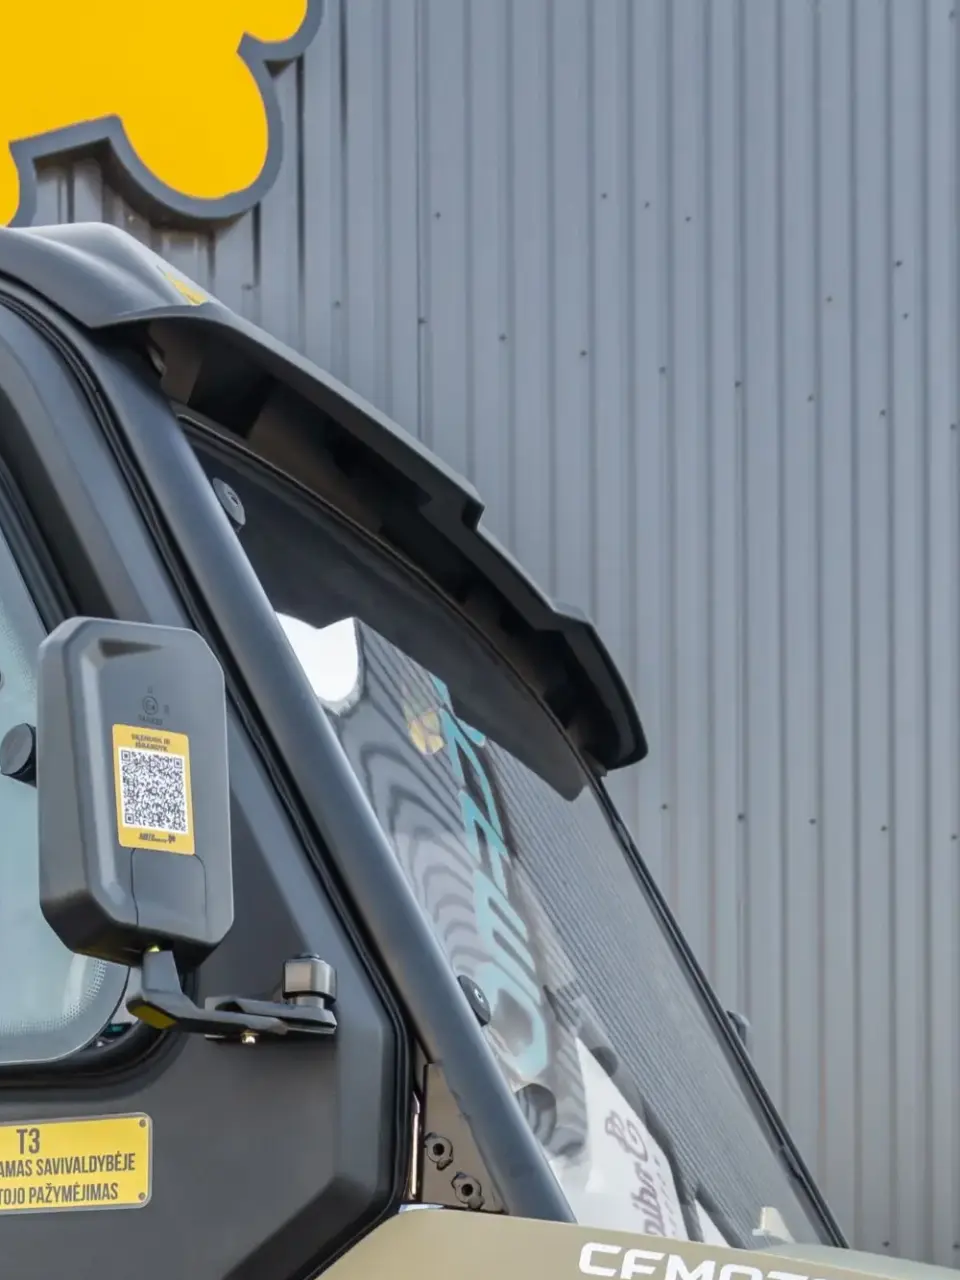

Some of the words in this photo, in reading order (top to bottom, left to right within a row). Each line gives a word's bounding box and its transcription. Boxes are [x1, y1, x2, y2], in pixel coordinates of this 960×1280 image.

[16, 1127, 40, 1154] T3
[36, 1151, 136, 1176] SAVIVALDYBĖJE
[29, 1181, 118, 1205] PAŽYMĖJIMAS
